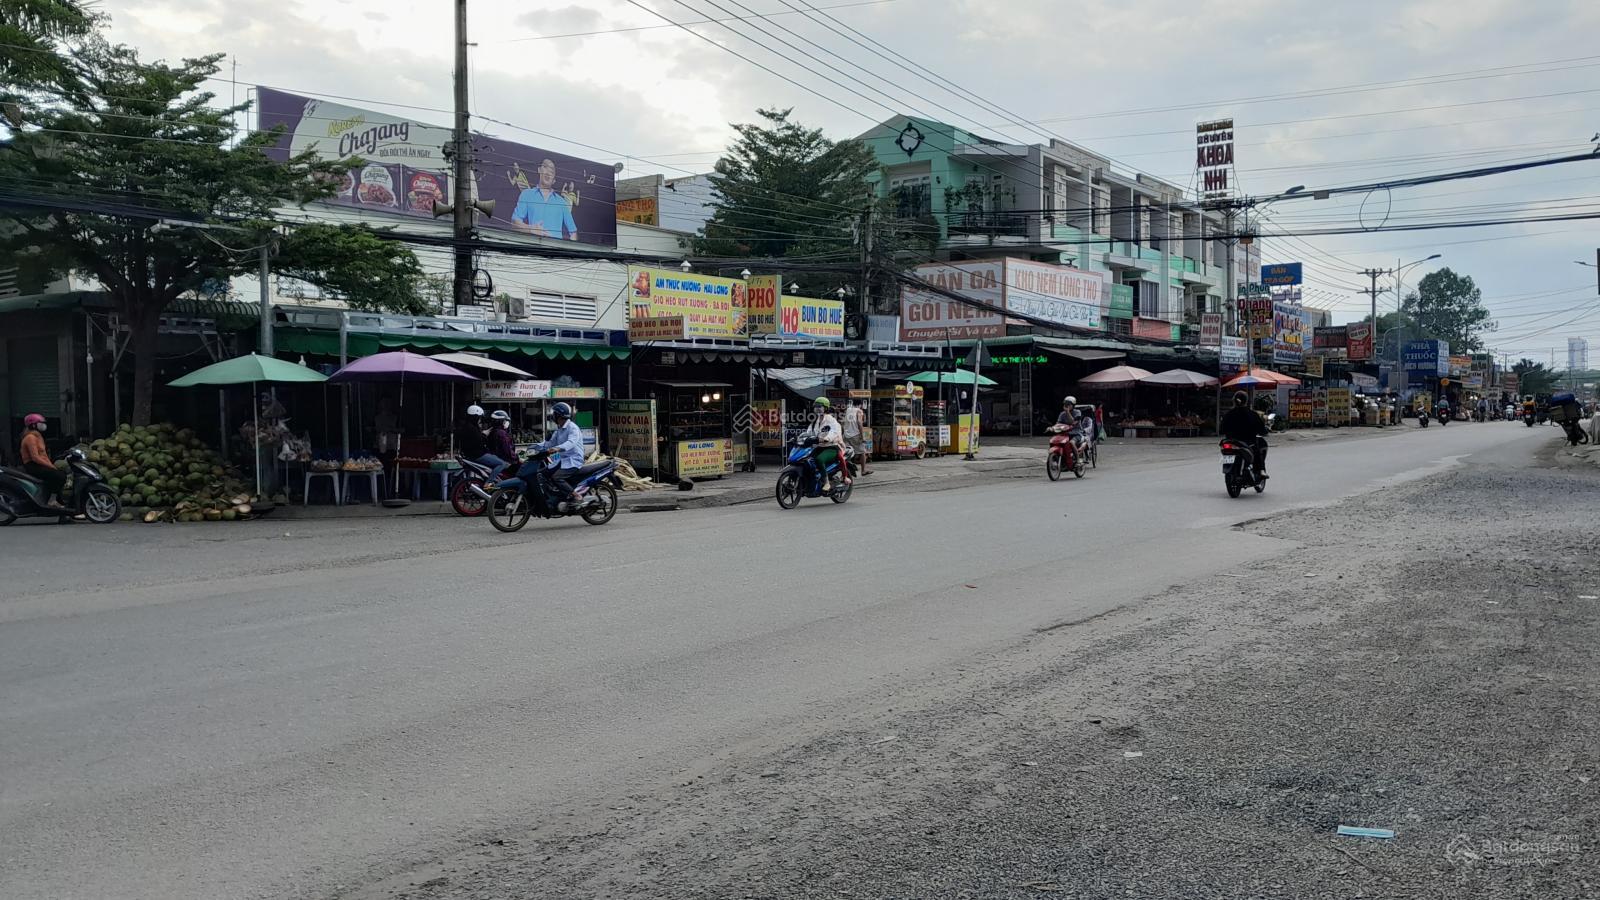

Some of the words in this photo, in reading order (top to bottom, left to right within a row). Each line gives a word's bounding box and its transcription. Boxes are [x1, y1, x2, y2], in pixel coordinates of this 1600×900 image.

[339, 122, 409, 158] Chajang
[1197, 143, 1233, 168] KHOA
[1204, 169, 1227, 191] NHI
